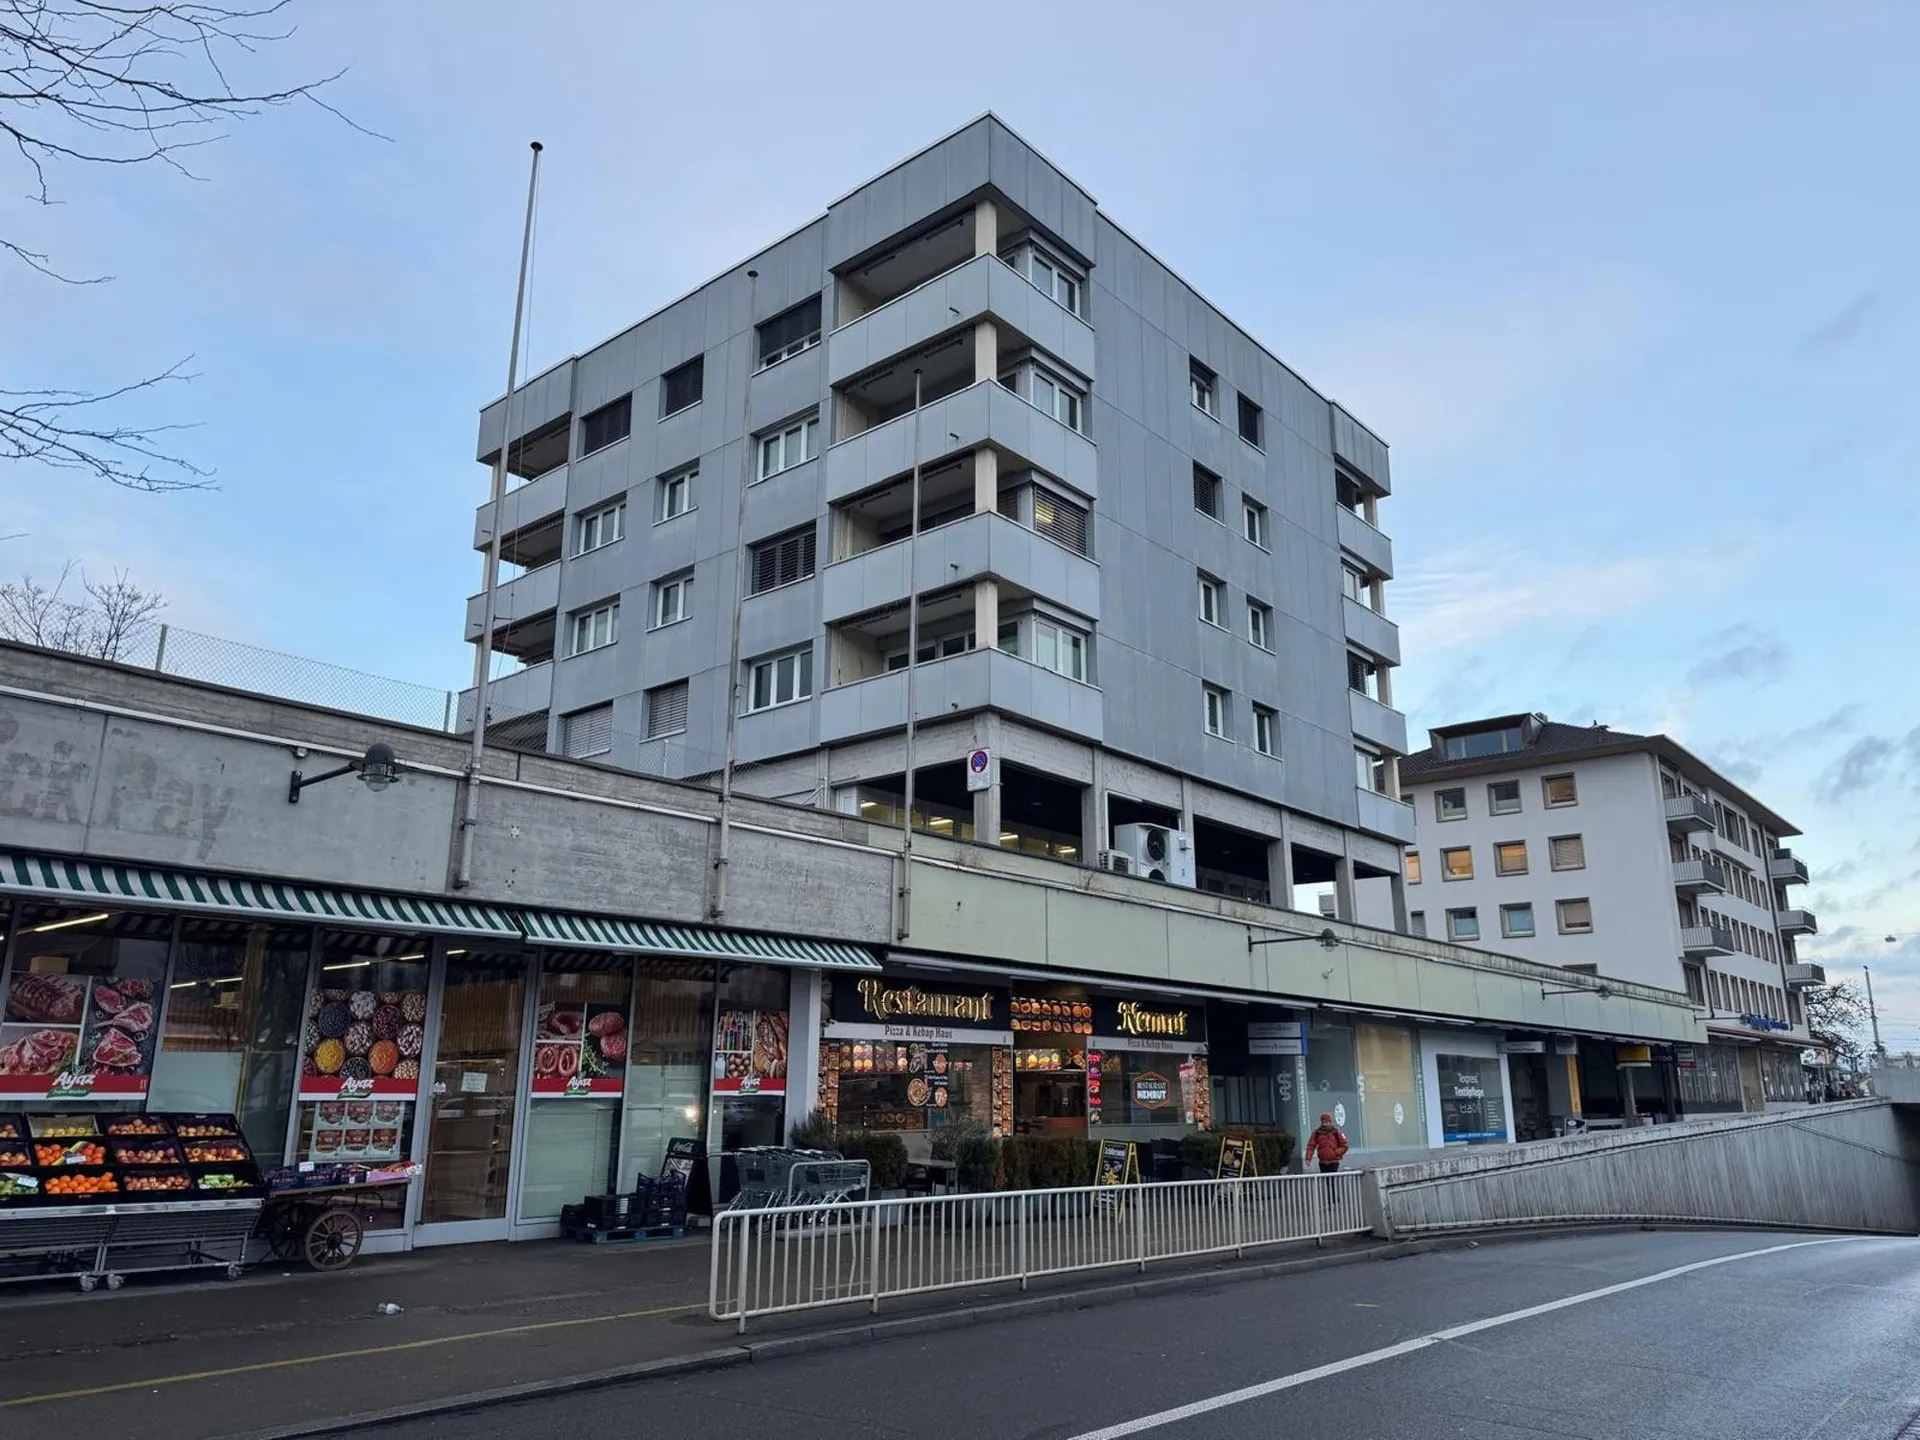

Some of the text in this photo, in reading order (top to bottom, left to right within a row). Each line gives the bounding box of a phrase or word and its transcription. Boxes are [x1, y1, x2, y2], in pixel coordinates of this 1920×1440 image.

[857, 978, 995, 1022] Restaurant
[1116, 1001, 1188, 1035] Nemrut
[885, 1025, 953, 1041] Pizza & Kebap Haus
[51, 1071, 96, 1089] Ayaz
[340, 1076, 375, 1092] Ayaz
[566, 1075, 592, 1090] Ayaz
[1136, 1090, 1167, 1099] NEMRUT
